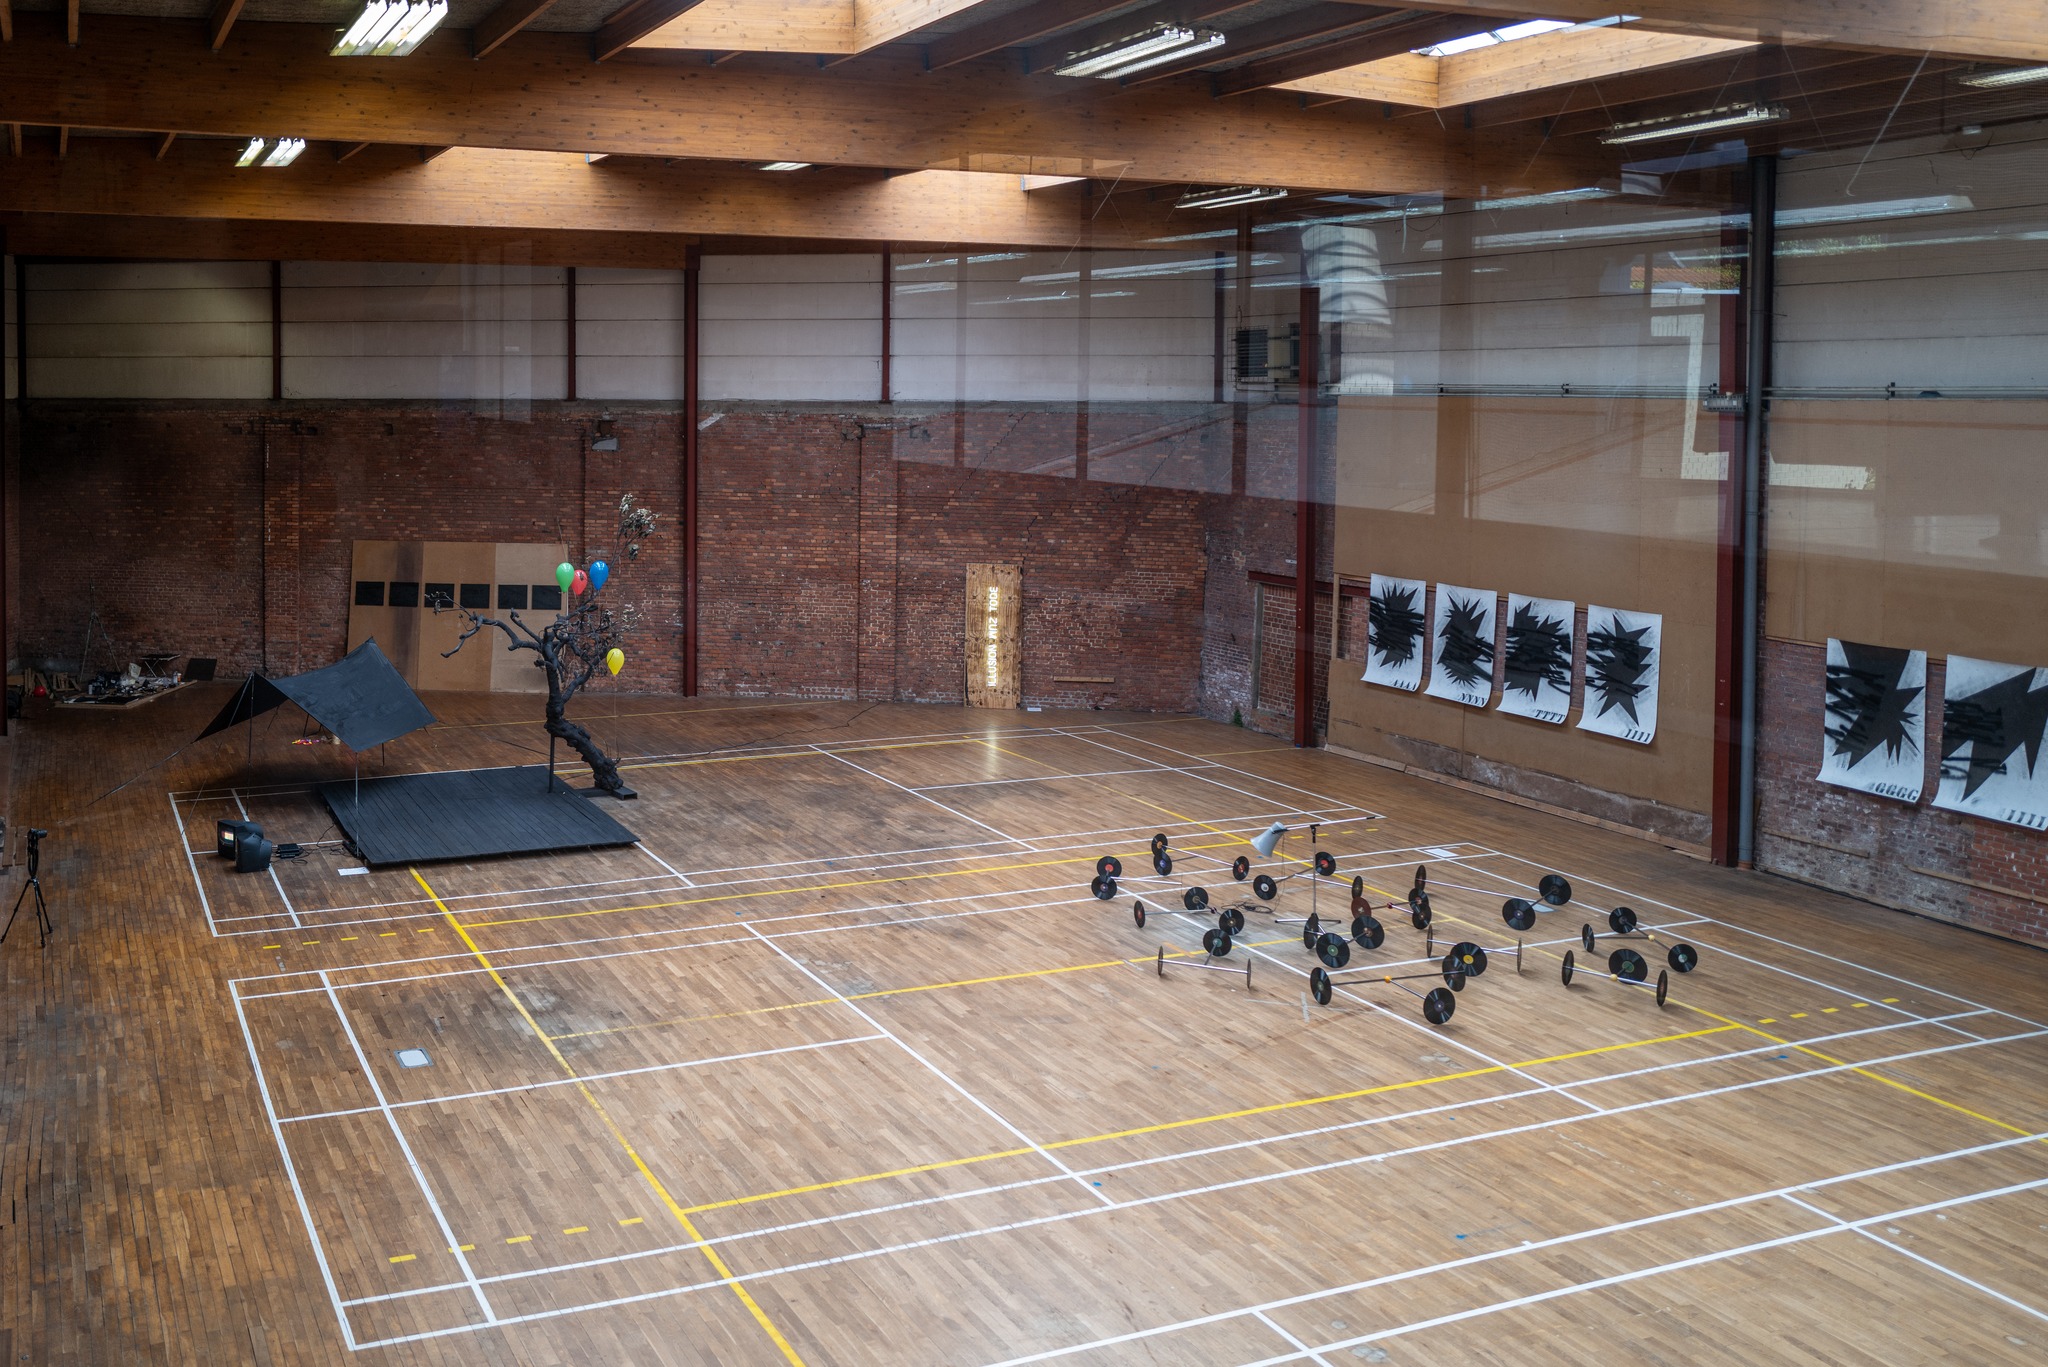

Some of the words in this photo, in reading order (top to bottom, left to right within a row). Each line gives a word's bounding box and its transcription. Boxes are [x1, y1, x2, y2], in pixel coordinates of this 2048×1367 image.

[988, 586, 999, 612] TODE
[987, 644, 997, 687] ILLUSION
[1534, 709, 1566, 723] TTTT
